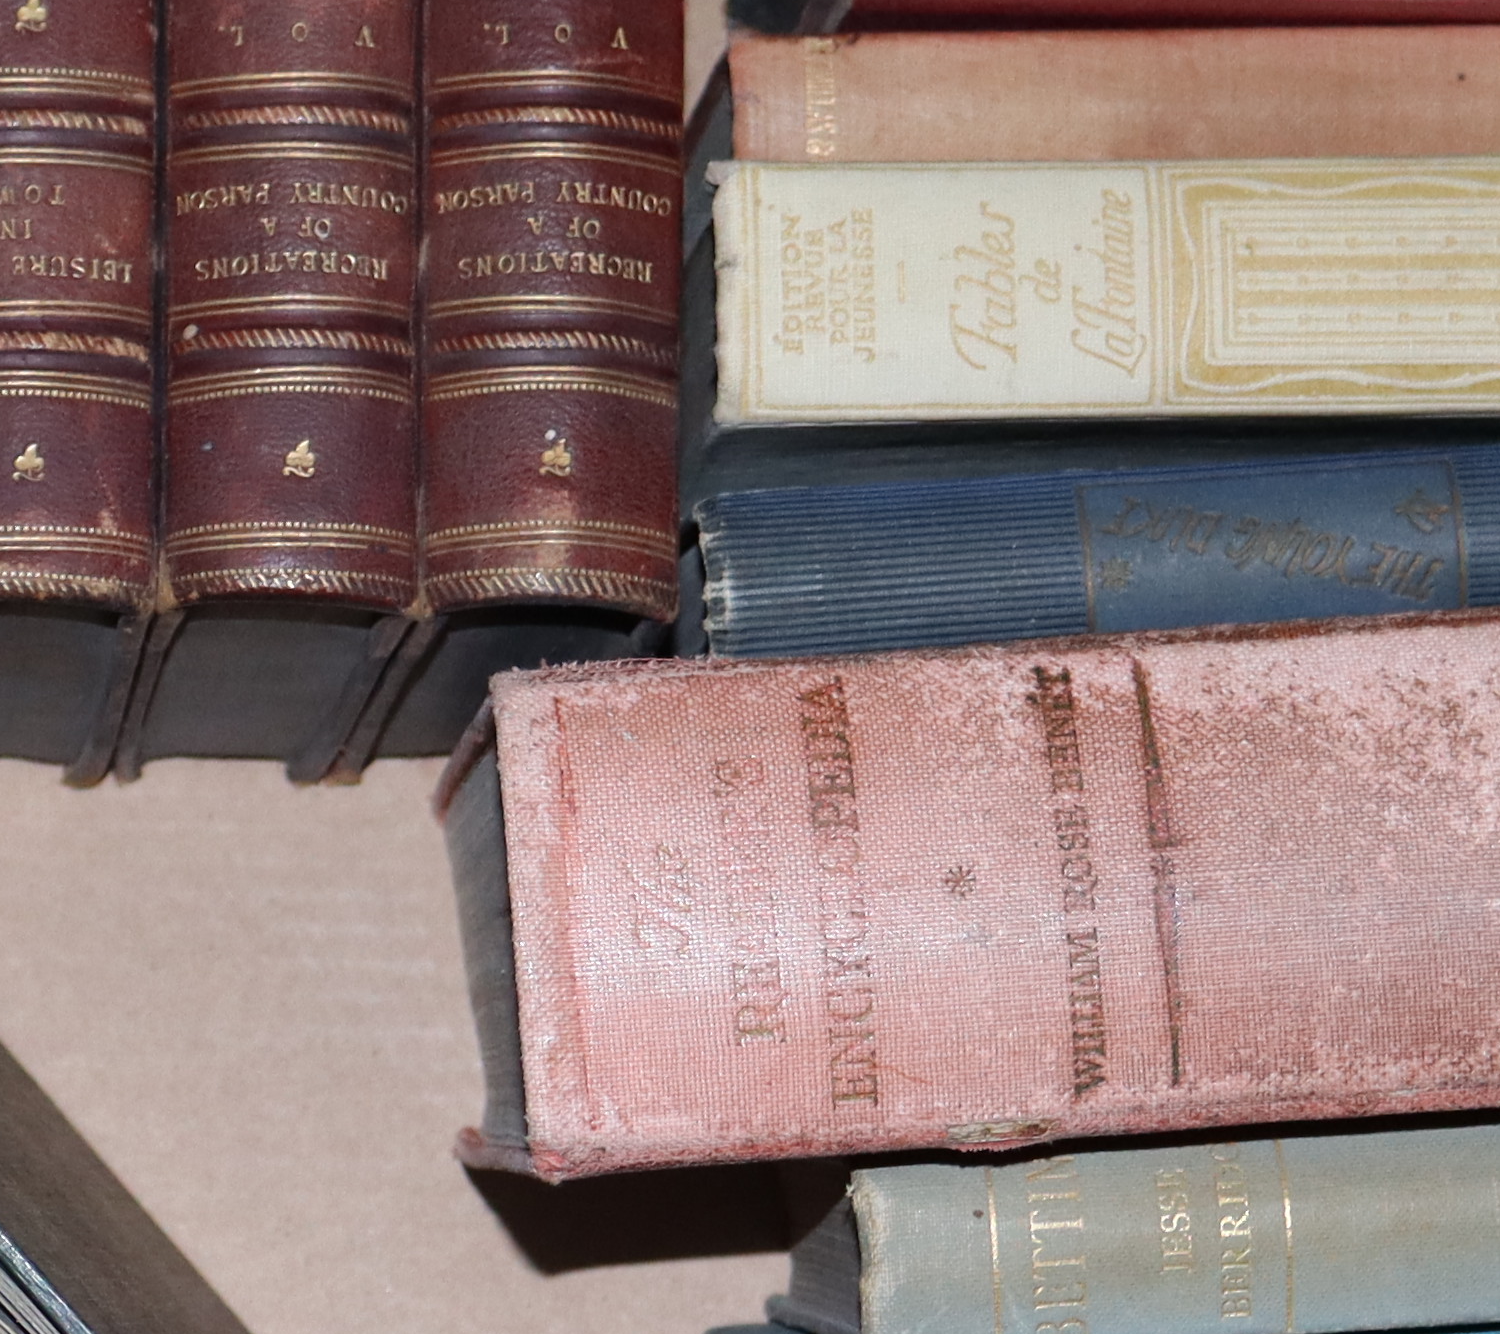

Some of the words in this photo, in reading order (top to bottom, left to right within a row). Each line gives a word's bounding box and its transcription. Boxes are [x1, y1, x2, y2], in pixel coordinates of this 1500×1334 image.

[176, 182, 271, 216] PARSON
[289, 182, 409, 214] COUNTRY
[436, 181, 536, 214] PARSON
[556, 180, 672, 216] COUNTRY
[0, 217, 34, 241] IN
[260, 216, 279, 237] A
[296, 216, 333, 240] OF
[526, 216, 545, 235] A
[565, 216, 601, 239] OF
[827, 217, 849, 255] LA
[11, 255, 134, 285] LEISURE
[194, 249, 389, 281] RECREATIONS
[458, 250, 653, 283] RECREATIONS
[851, 207, 877, 363] JEUNESSE
[948, 200, 1020, 371] Fables
[1017, 258, 1064, 307] de
[828, 264, 851, 345] POUR
[1054, 804, 1099, 915] ROSE
[1065, 926, 1109, 1097] WILLIAM
